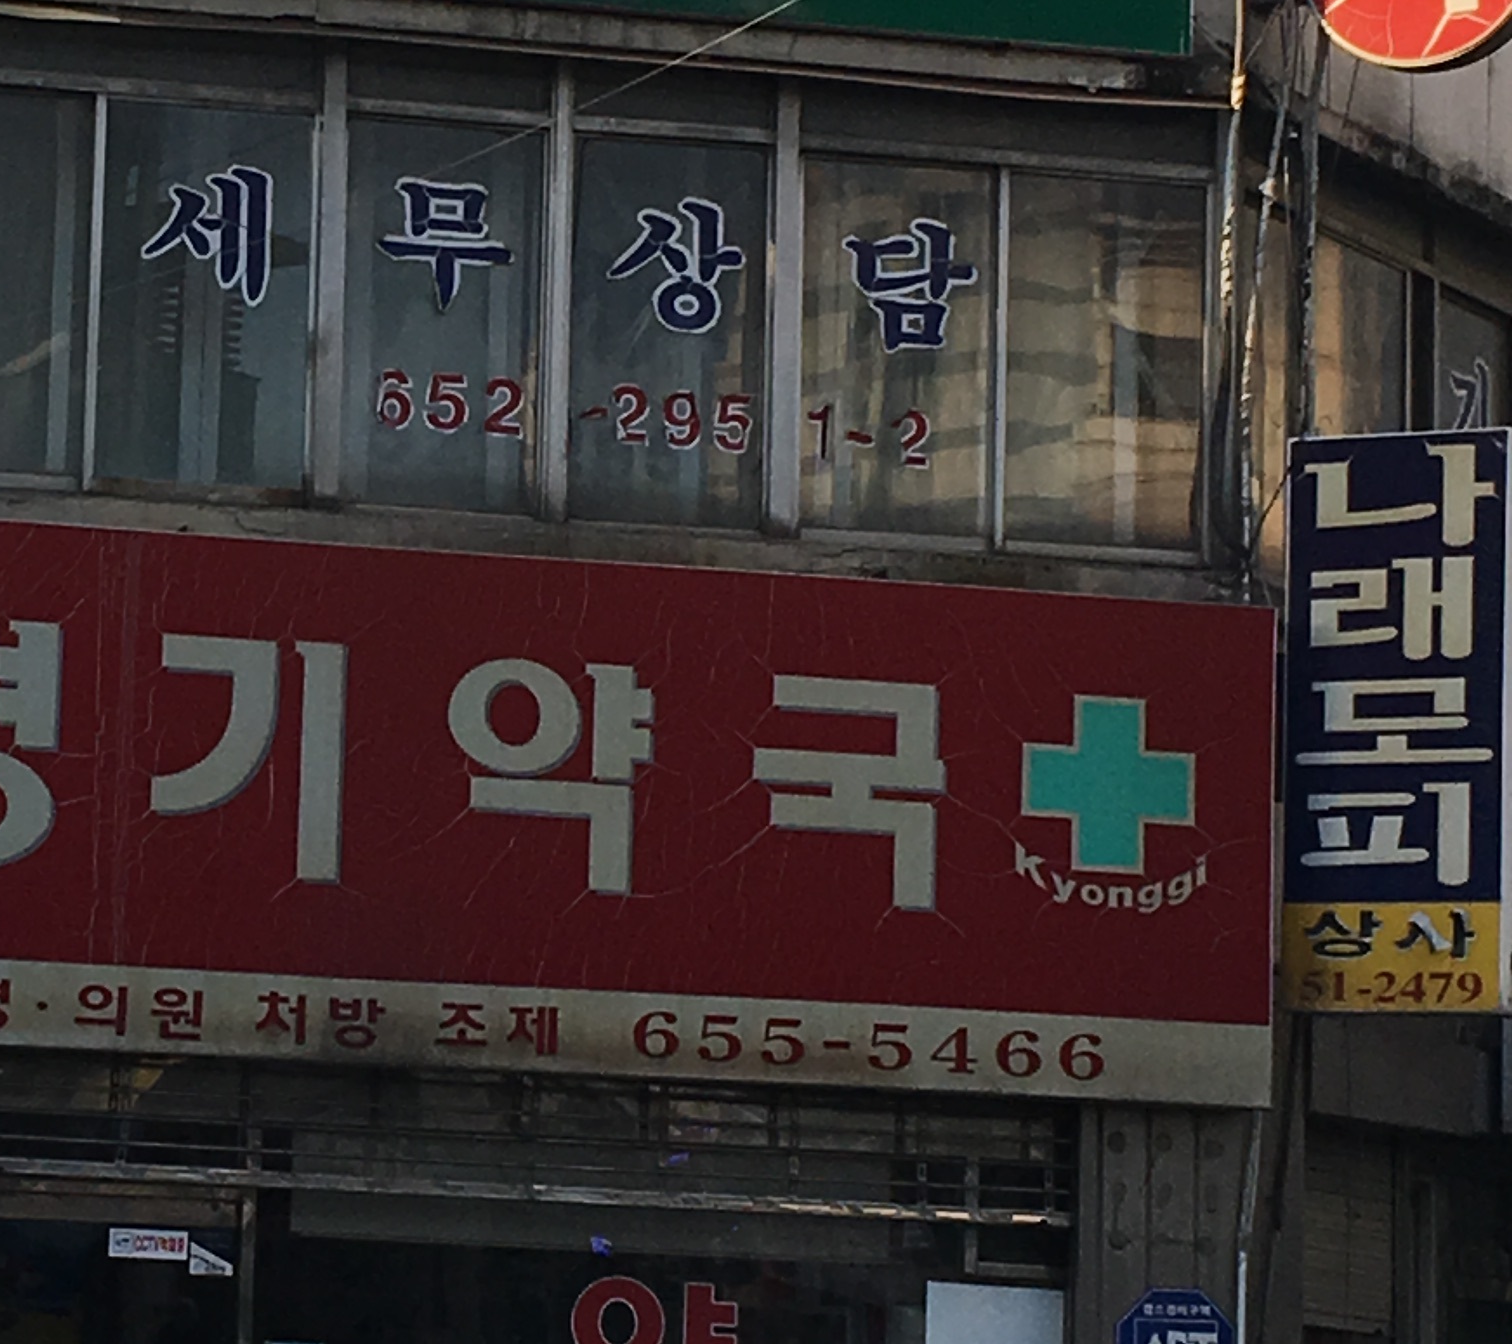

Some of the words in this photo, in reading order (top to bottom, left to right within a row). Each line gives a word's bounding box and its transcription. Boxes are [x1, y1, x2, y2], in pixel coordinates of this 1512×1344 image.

[1295, 443, 1498, 887] 나래모피
[1011, 842, 1211, 915] Kyonggi
[1301, 909, 1476, 960] 상사
[254, 987, 387, 1048] 처방
[433, 995, 562, 1056] 조제
[631, 1009, 1108, 1084] 655-5466
